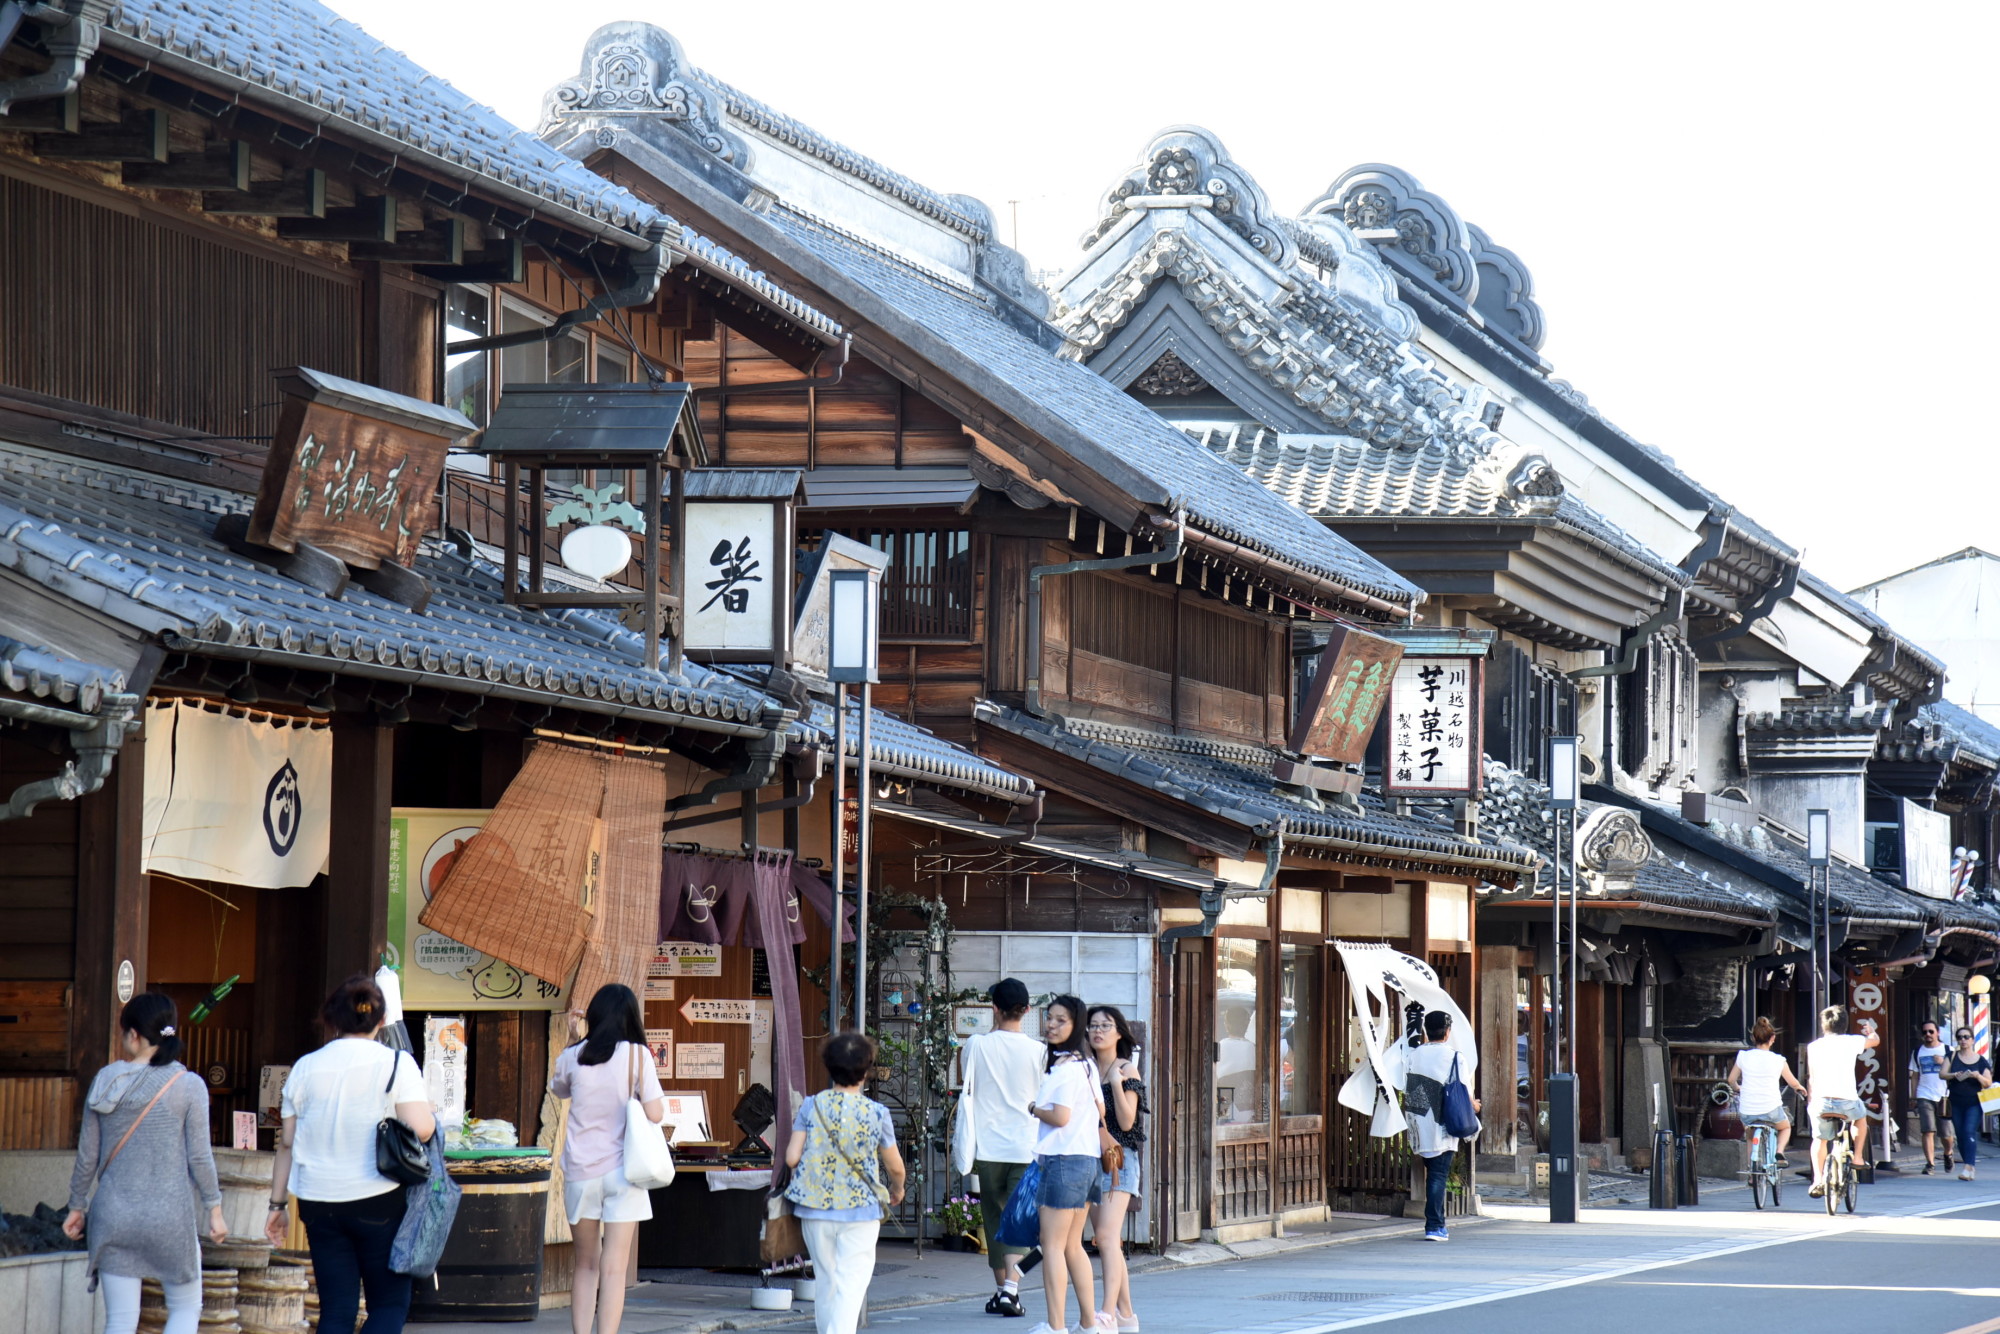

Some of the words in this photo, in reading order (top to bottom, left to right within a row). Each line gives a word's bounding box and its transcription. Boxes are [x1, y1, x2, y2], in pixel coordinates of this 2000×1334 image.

[696, 536, 763, 614] 箸
[1417, 664, 1444, 783] 芋菓子
[1447, 669, 1466, 749] 川越名物
[389, 828, 401, 895] 健康志向野菜
[657, 946, 713, 957] お名前入れ
